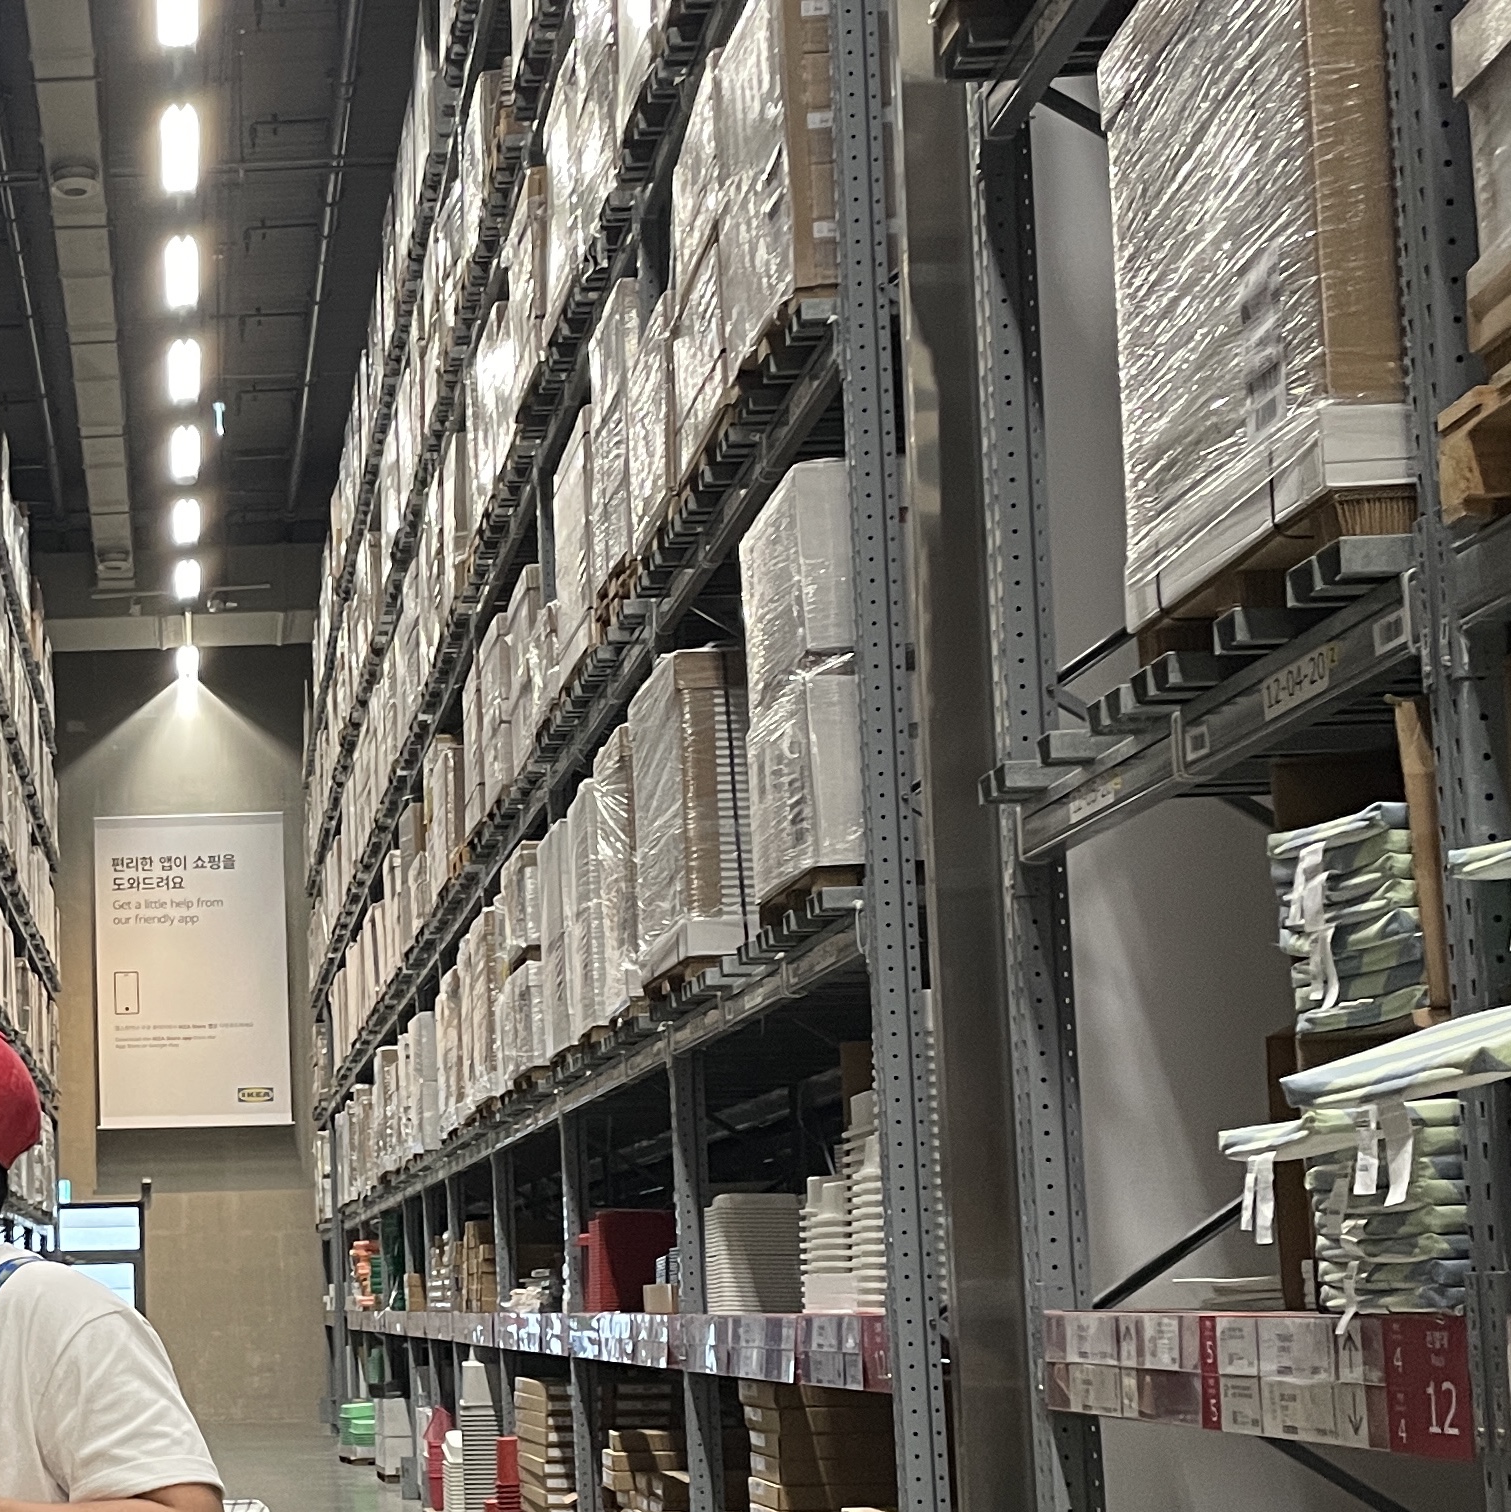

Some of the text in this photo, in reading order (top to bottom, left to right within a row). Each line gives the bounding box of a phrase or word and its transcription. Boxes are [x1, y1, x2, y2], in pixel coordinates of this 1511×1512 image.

[1266, 652, 1326, 709] 12-04-20
[111, 853, 236, 872] 편리한 앱이 쇼핑을
[112, 875, 185, 891] 도와드려요
[112, 897, 224, 911] Get a little help from
[113, 914, 199, 927] our friendly app
[1206, 1341, 1214, 1363] 5
[1393, 1347, 1403, 1373] 4
[1210, 1398, 1218, 1422] 5
[1426, 1380, 1460, 1435] 12
[1398, 1418, 1407, 1444] 4
